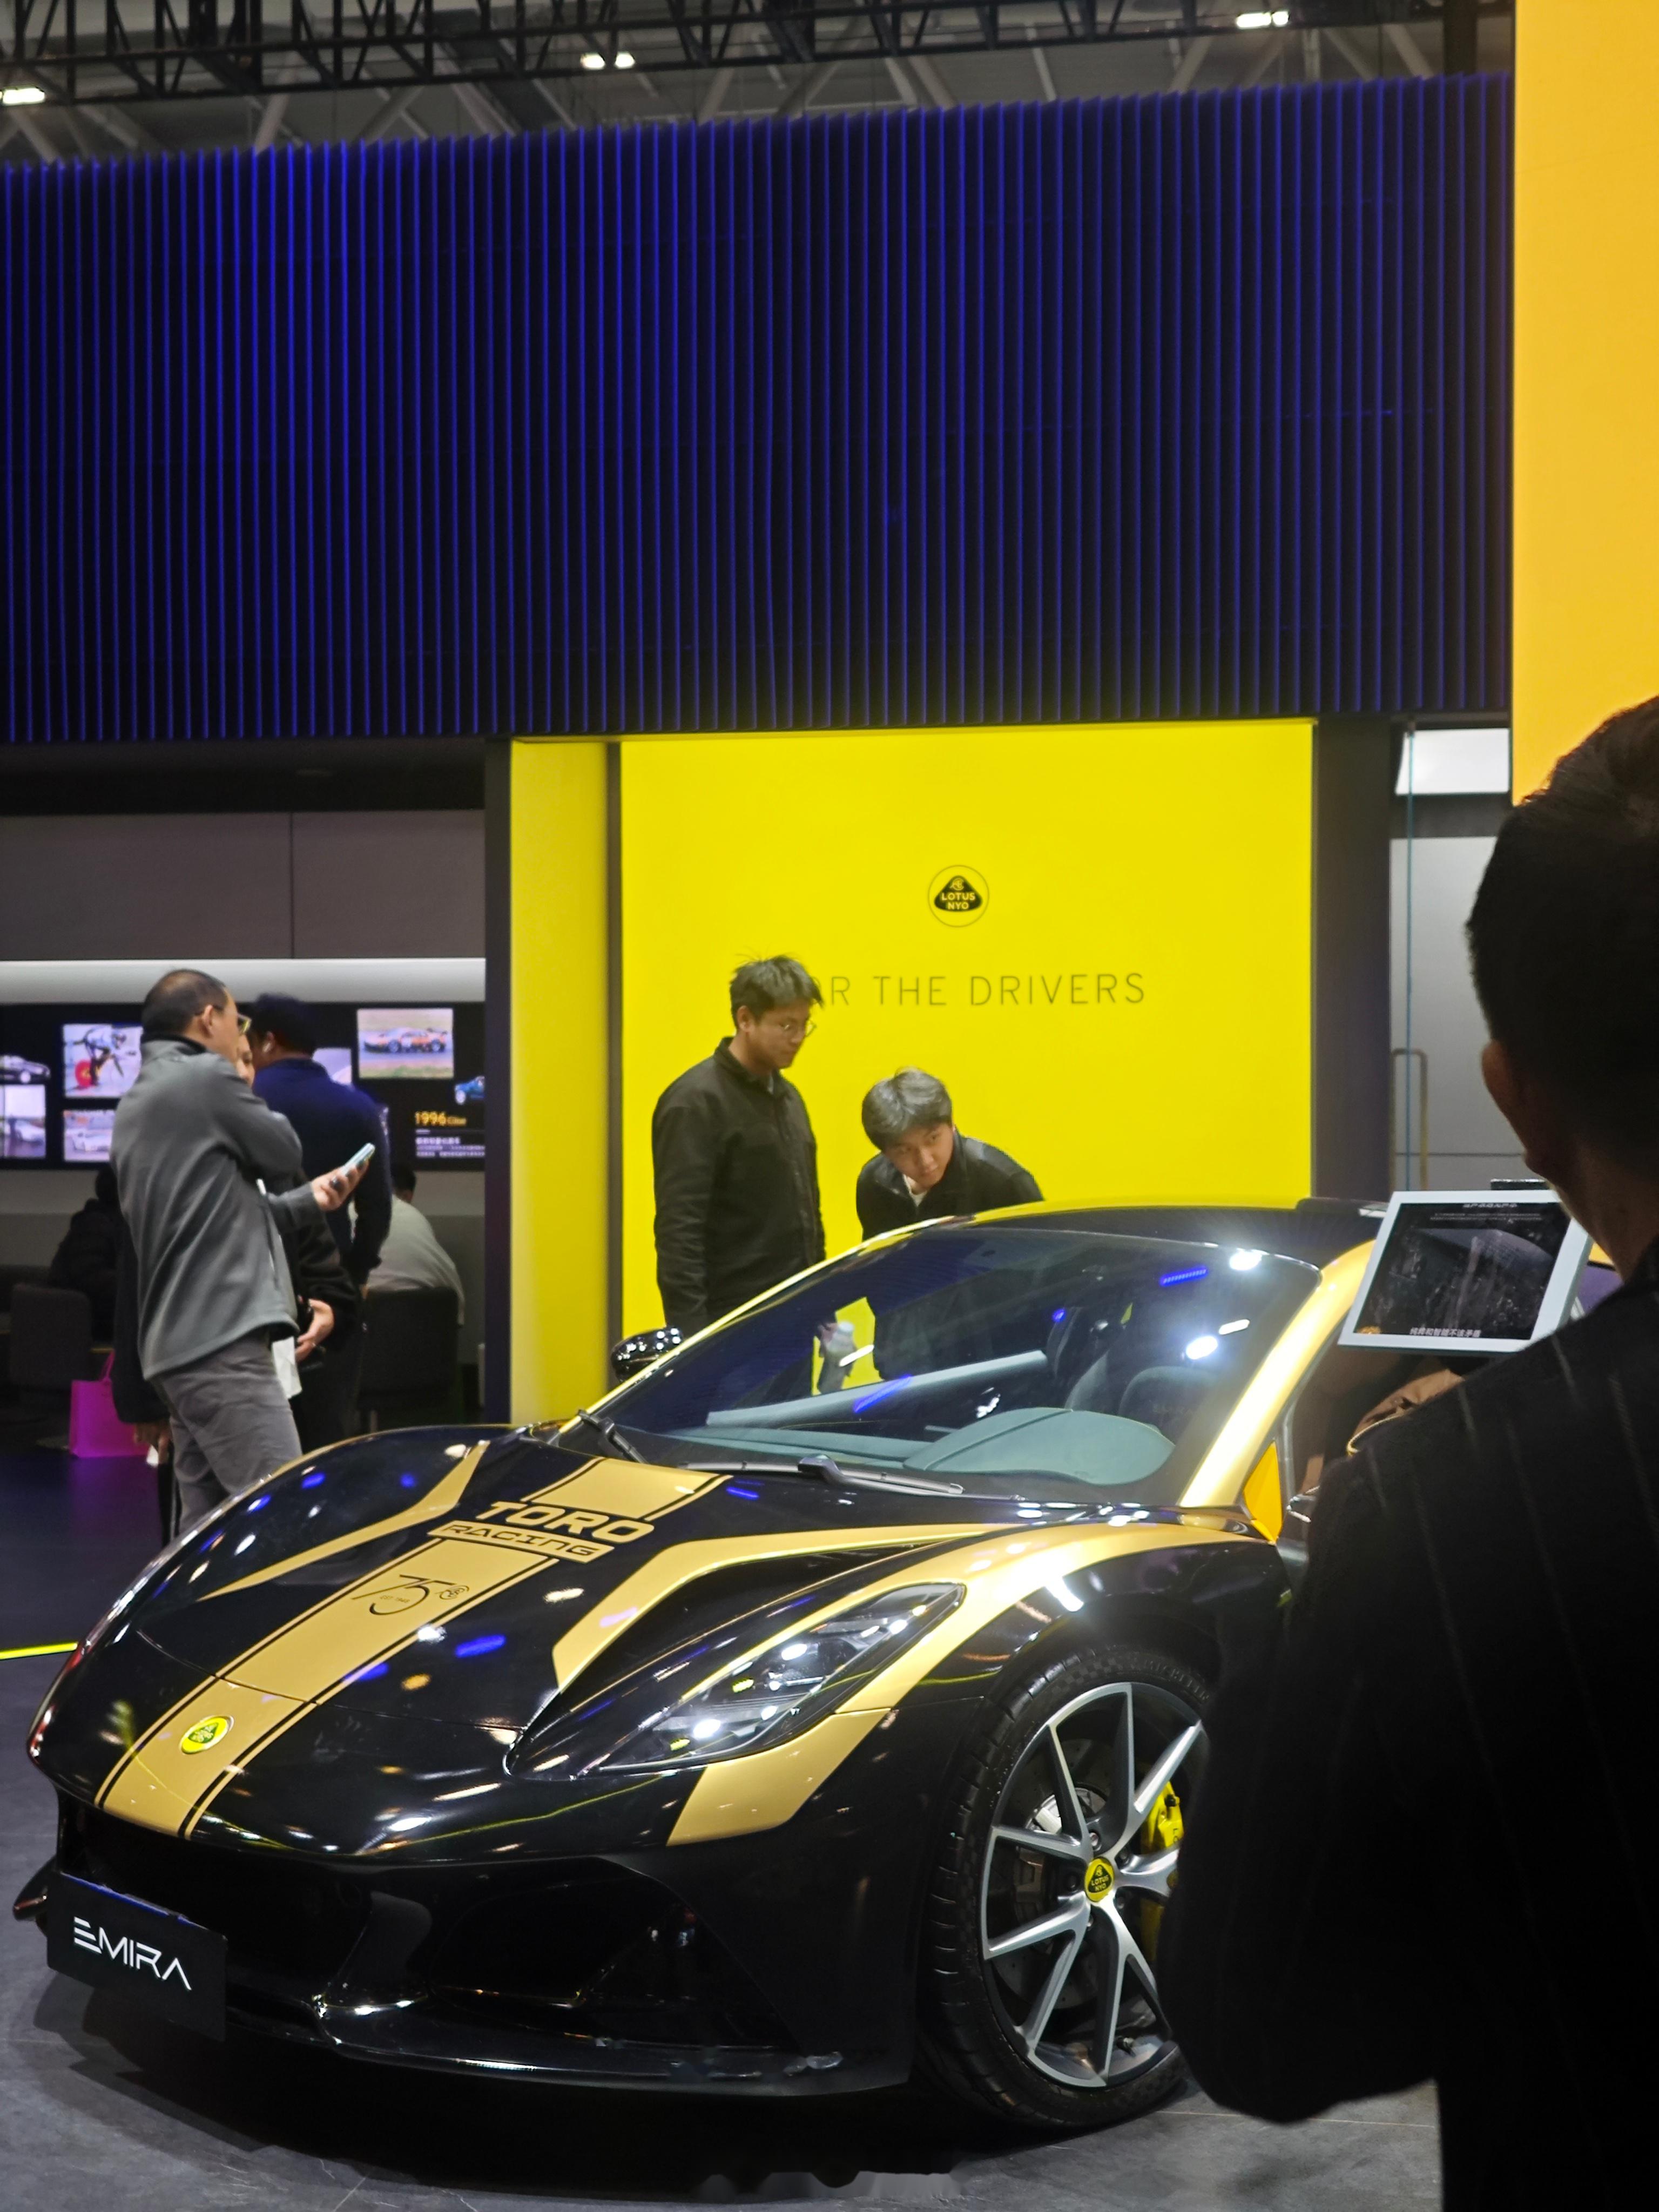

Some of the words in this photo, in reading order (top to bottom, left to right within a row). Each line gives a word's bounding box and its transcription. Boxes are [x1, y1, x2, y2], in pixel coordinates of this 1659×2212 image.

[941, 892, 976, 901] LOTUS
[948, 901, 969, 910] NYO
[873, 976, 946, 1006] THE
[972, 973, 1145, 1006] DRIVERS
[415, 1111, 447, 1126] 1996
[476, 1501, 655, 1544] TORO
[442, 1523, 597, 1557] RACING
[351, 1574, 457, 1615] 75
[1091, 1874, 1109, 1886] LOTUS
[73, 1916, 192, 1992] EMIRA
